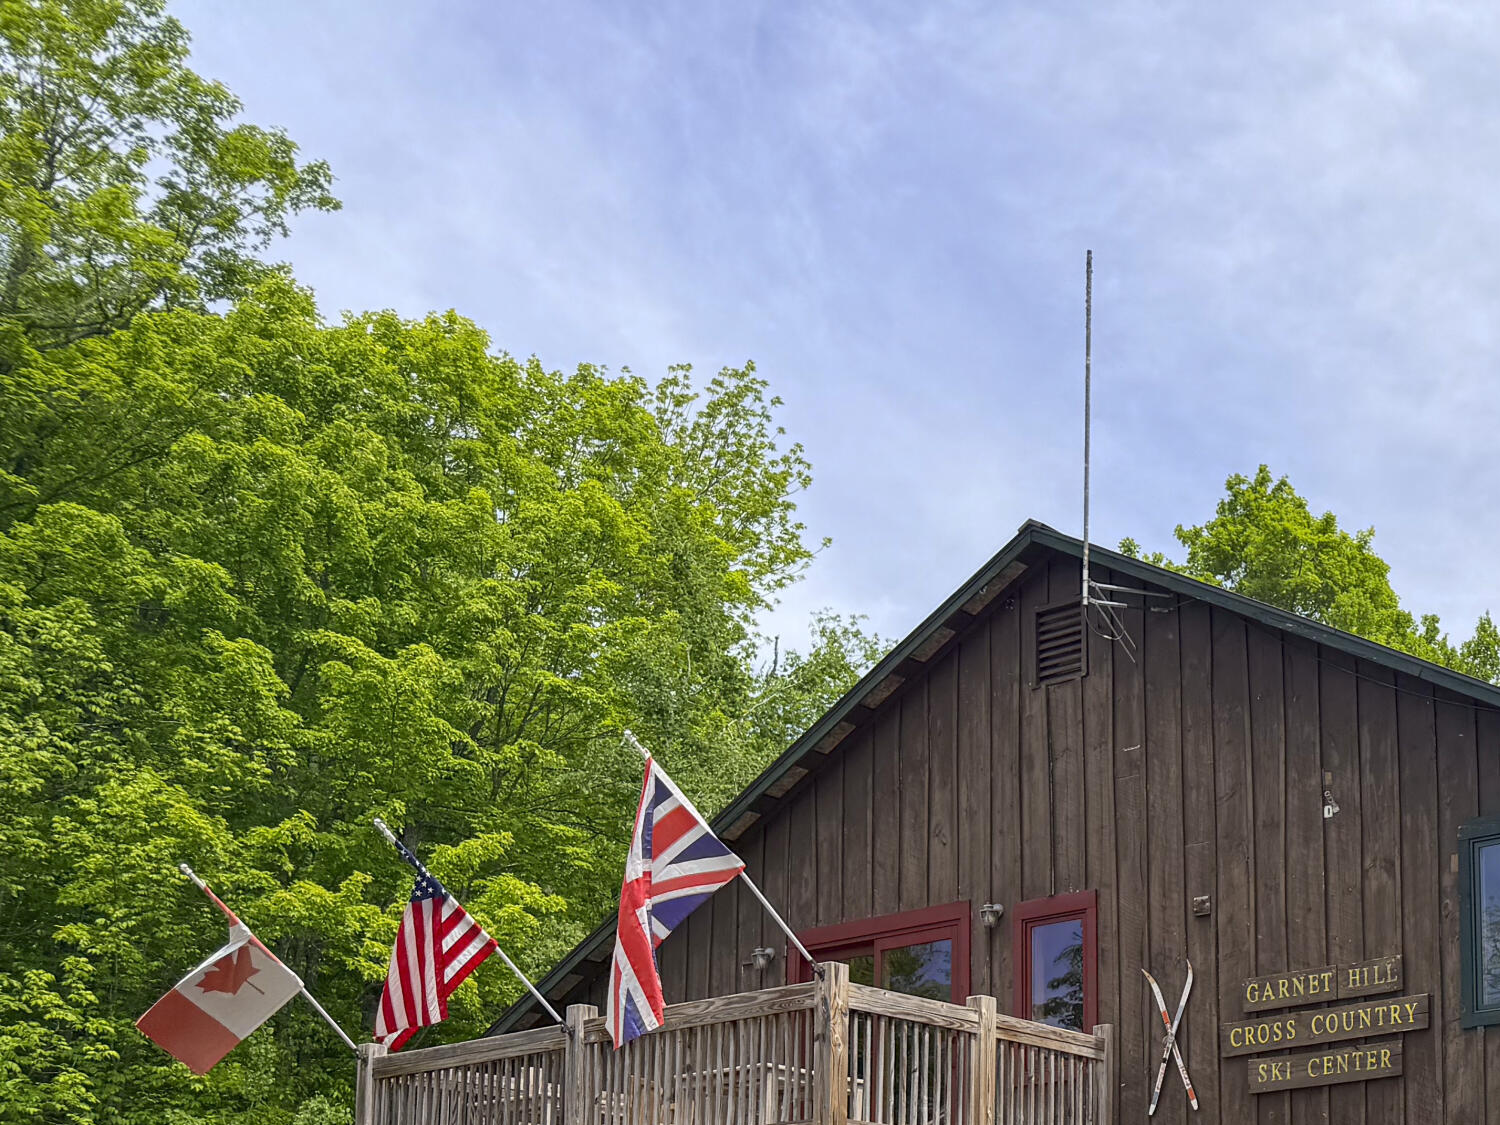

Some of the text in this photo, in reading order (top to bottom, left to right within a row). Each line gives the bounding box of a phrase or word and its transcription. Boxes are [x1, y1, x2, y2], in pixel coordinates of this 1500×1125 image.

[1246, 963, 1398, 1003] GARNET HILL
[1230, 1002, 1418, 1048] CROSS COUNTRY
[1258, 1049, 1392, 1083] SKI CENTER
